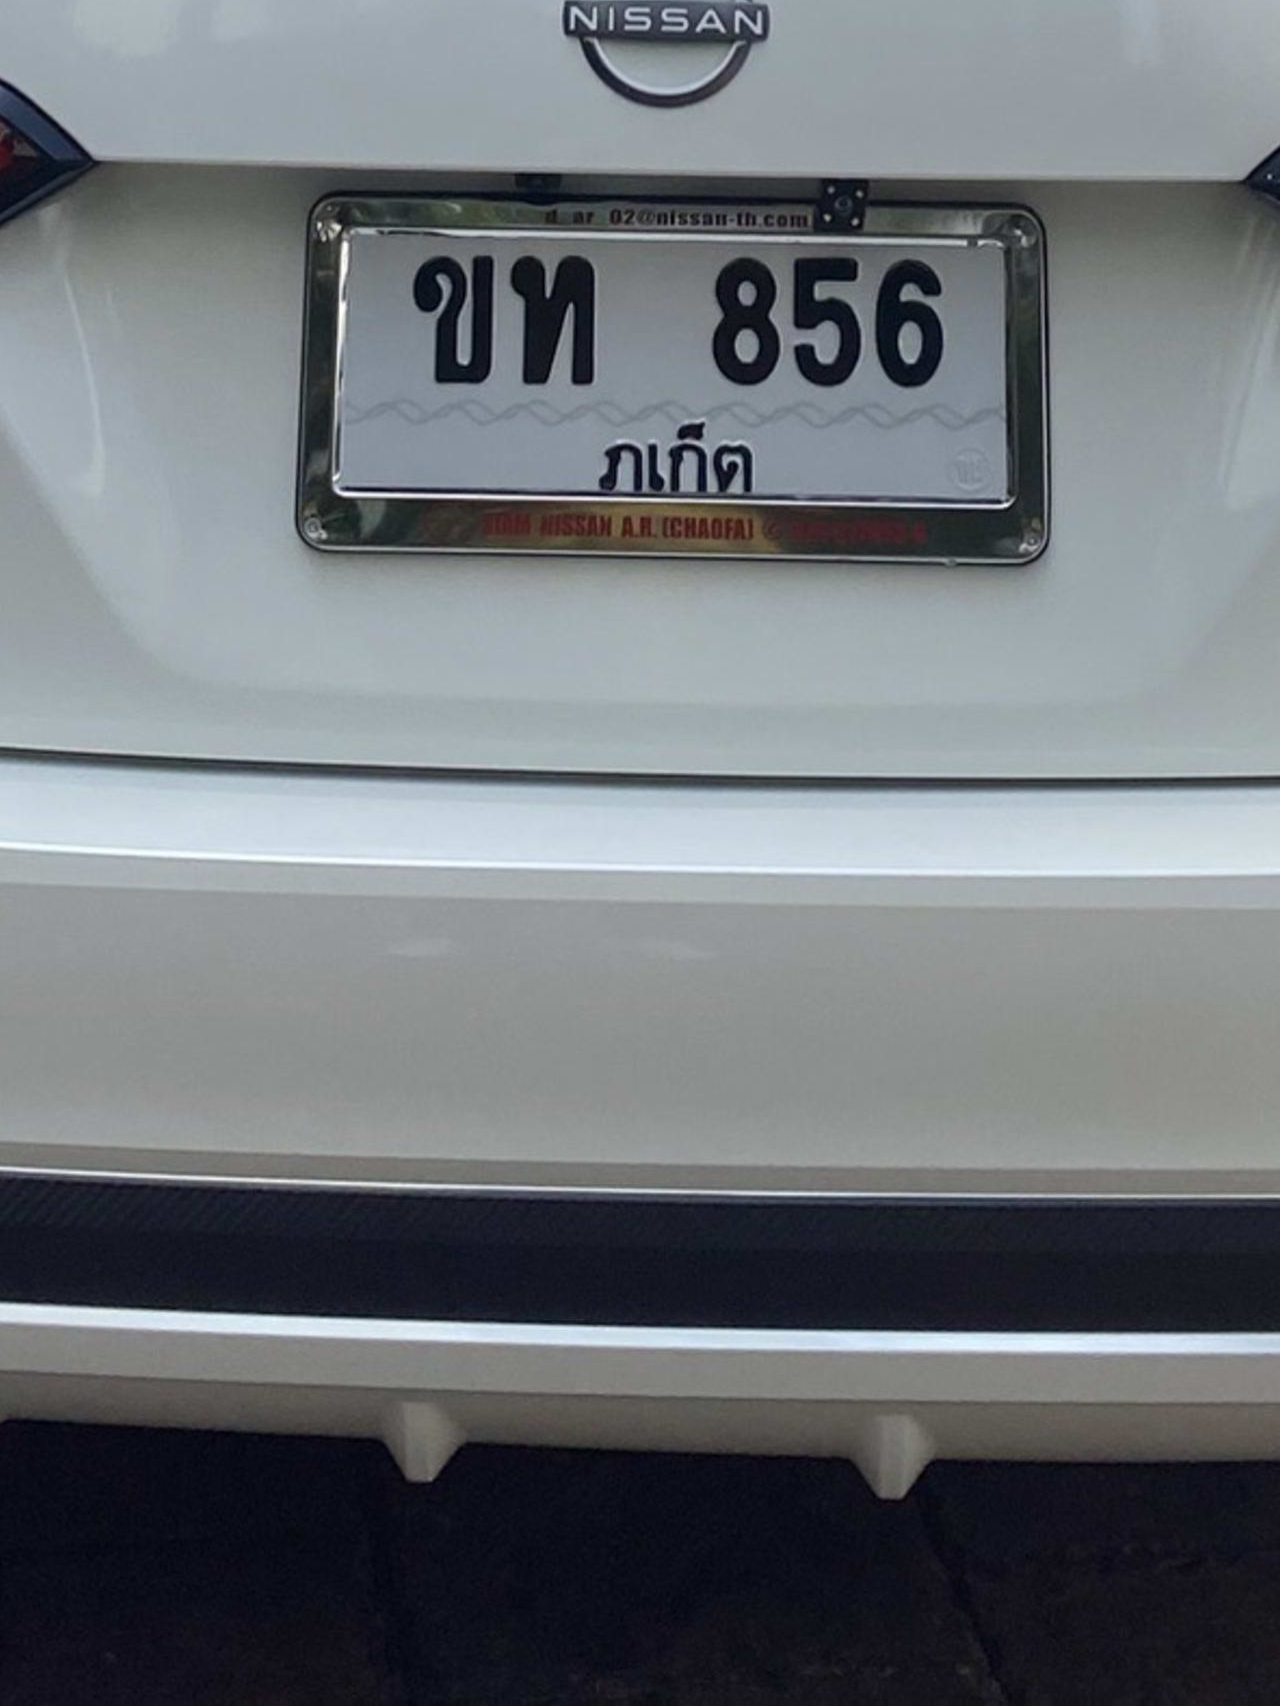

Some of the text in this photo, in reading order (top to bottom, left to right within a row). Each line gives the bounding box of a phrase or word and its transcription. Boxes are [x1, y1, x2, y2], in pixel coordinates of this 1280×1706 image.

[569, 5, 764, 36] NISSAN
[413, 255, 944, 388] ขท 856
[598, 421, 753, 493] ภเก็ต
[540, 513, 613, 538] NISSAN
